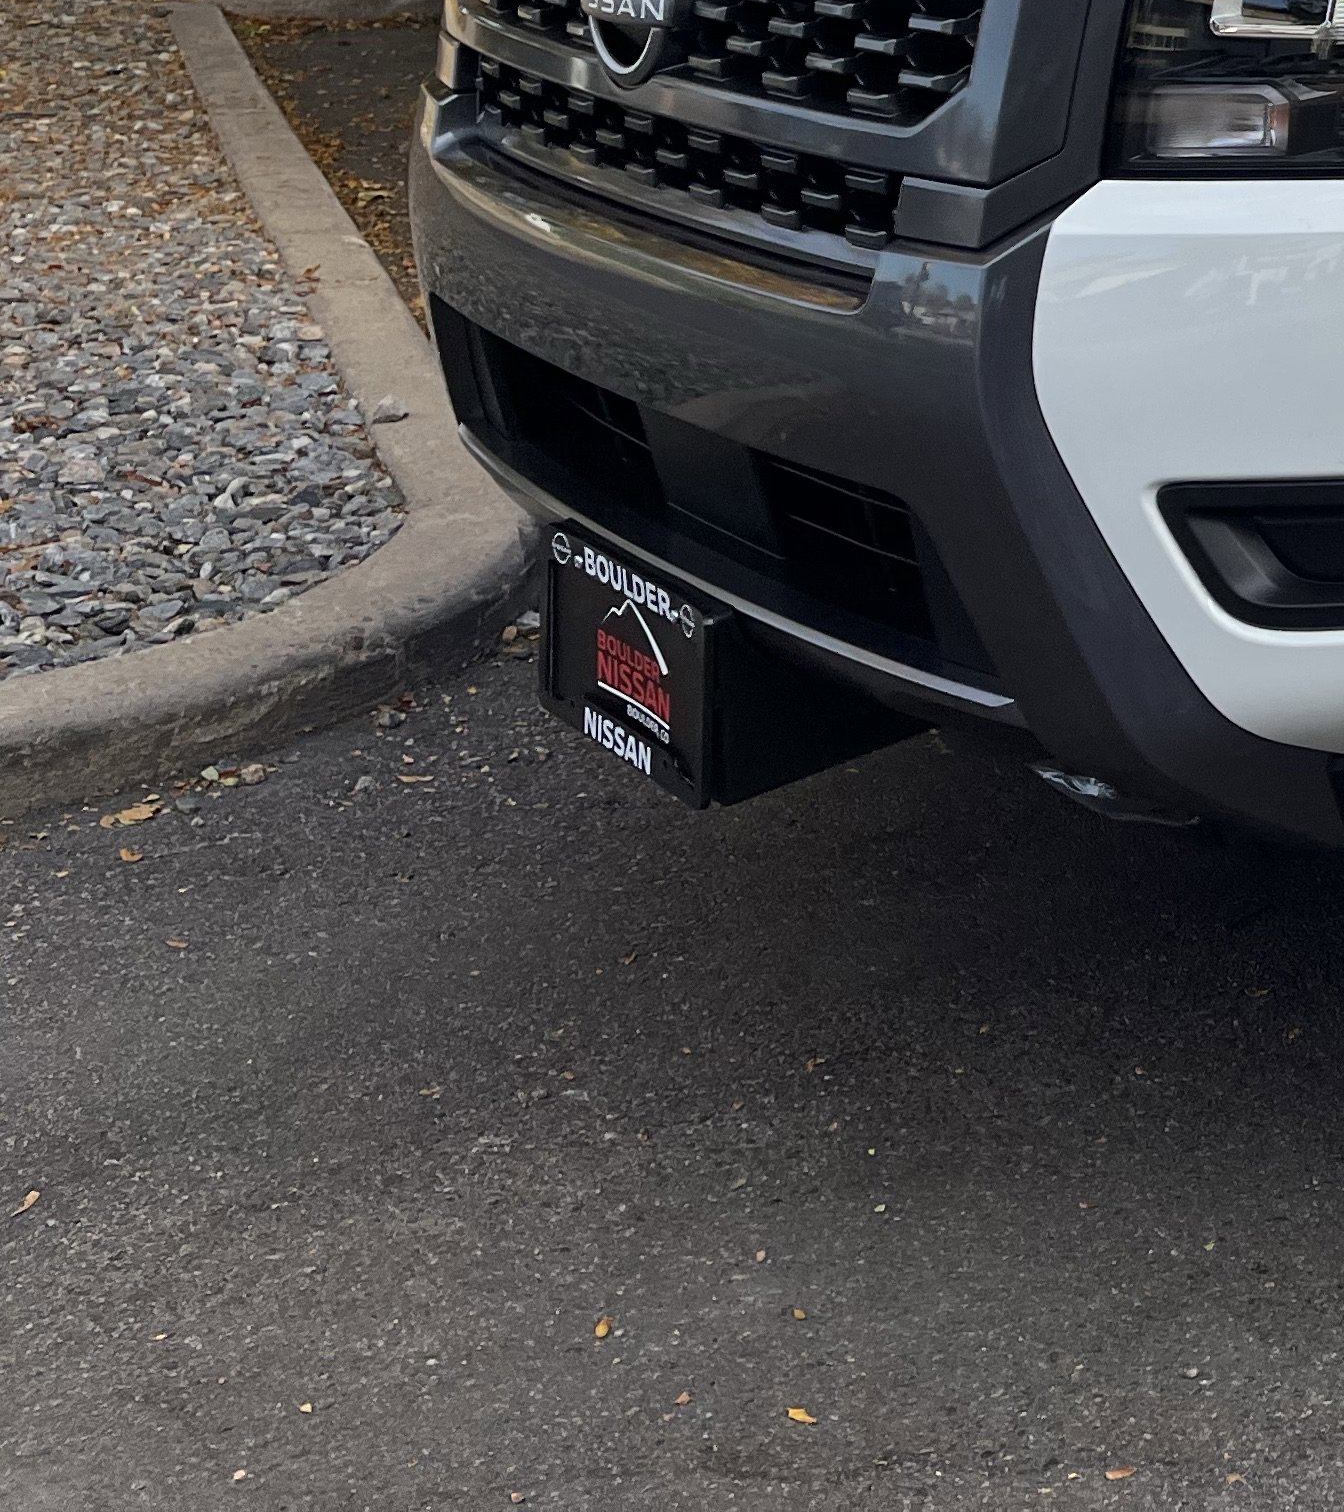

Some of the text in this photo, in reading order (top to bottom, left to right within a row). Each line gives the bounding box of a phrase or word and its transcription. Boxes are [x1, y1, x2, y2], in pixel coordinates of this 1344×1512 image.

[583, 546, 674, 622] BOULDER
[597, 629, 660, 683] BOULDER
[597, 650, 670, 723] NISSAN
[583, 706, 651, 775] NISSAN
